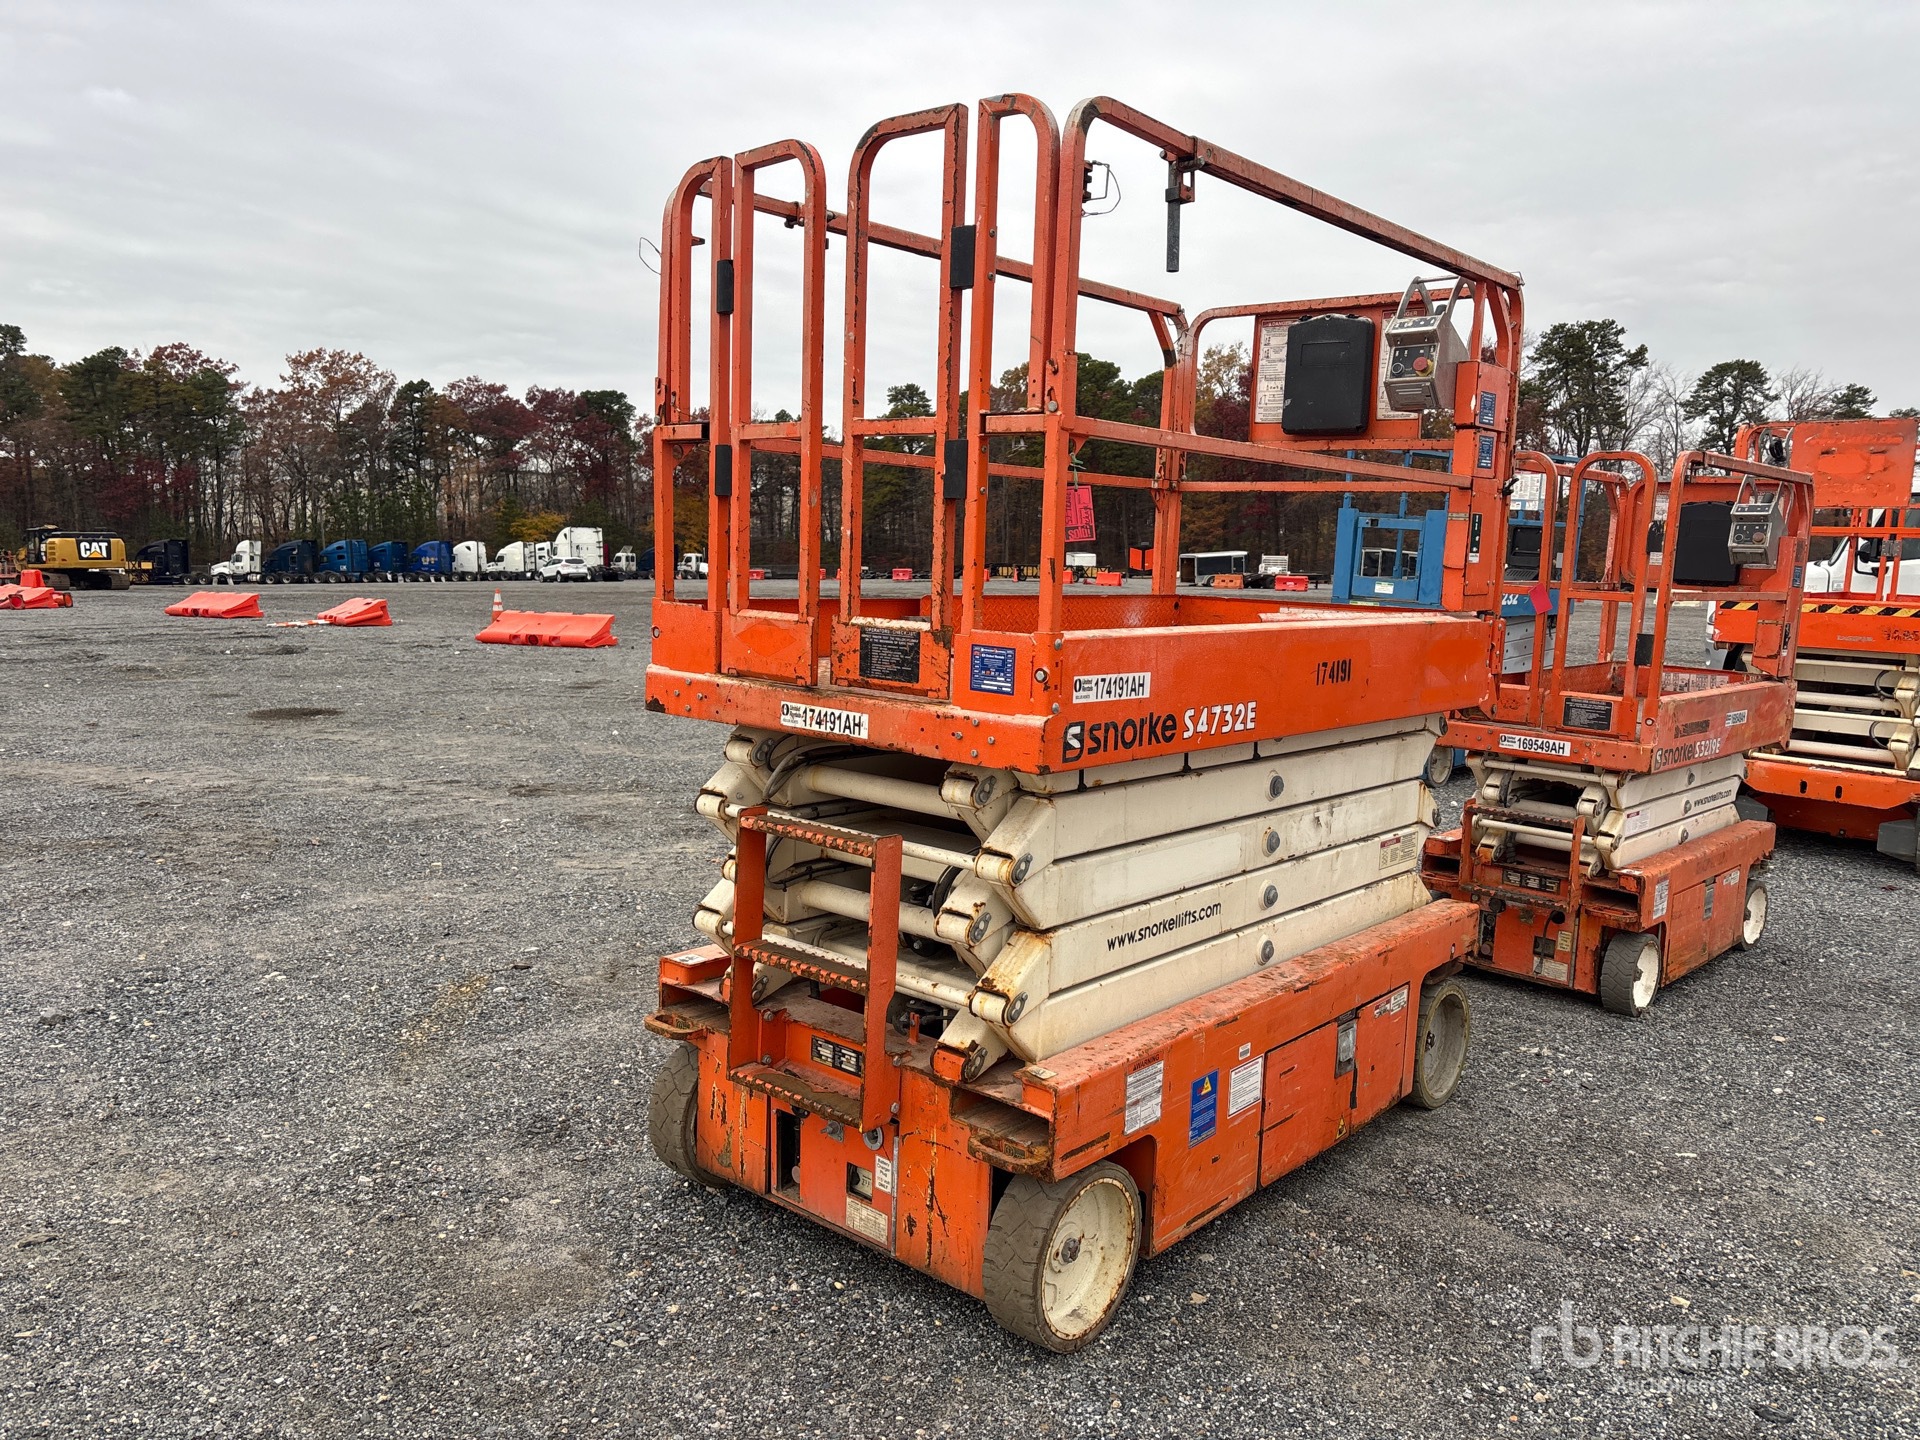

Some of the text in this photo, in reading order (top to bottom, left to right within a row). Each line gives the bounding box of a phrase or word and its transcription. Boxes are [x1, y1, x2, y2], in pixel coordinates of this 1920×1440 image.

[79, 541, 108, 559] CAT
[1315, 658, 1352, 686] 174191
[1094, 675, 1146, 700] 174191AH
[802, 706, 862, 736] 174191AH
[1182, 700, 1258, 741] S4732E
[1517, 736, 1566, 755] 169549AH
[1662, 742, 1696, 767] snorkel
[1106, 902, 1222, 952] www.snorkellifts.com
